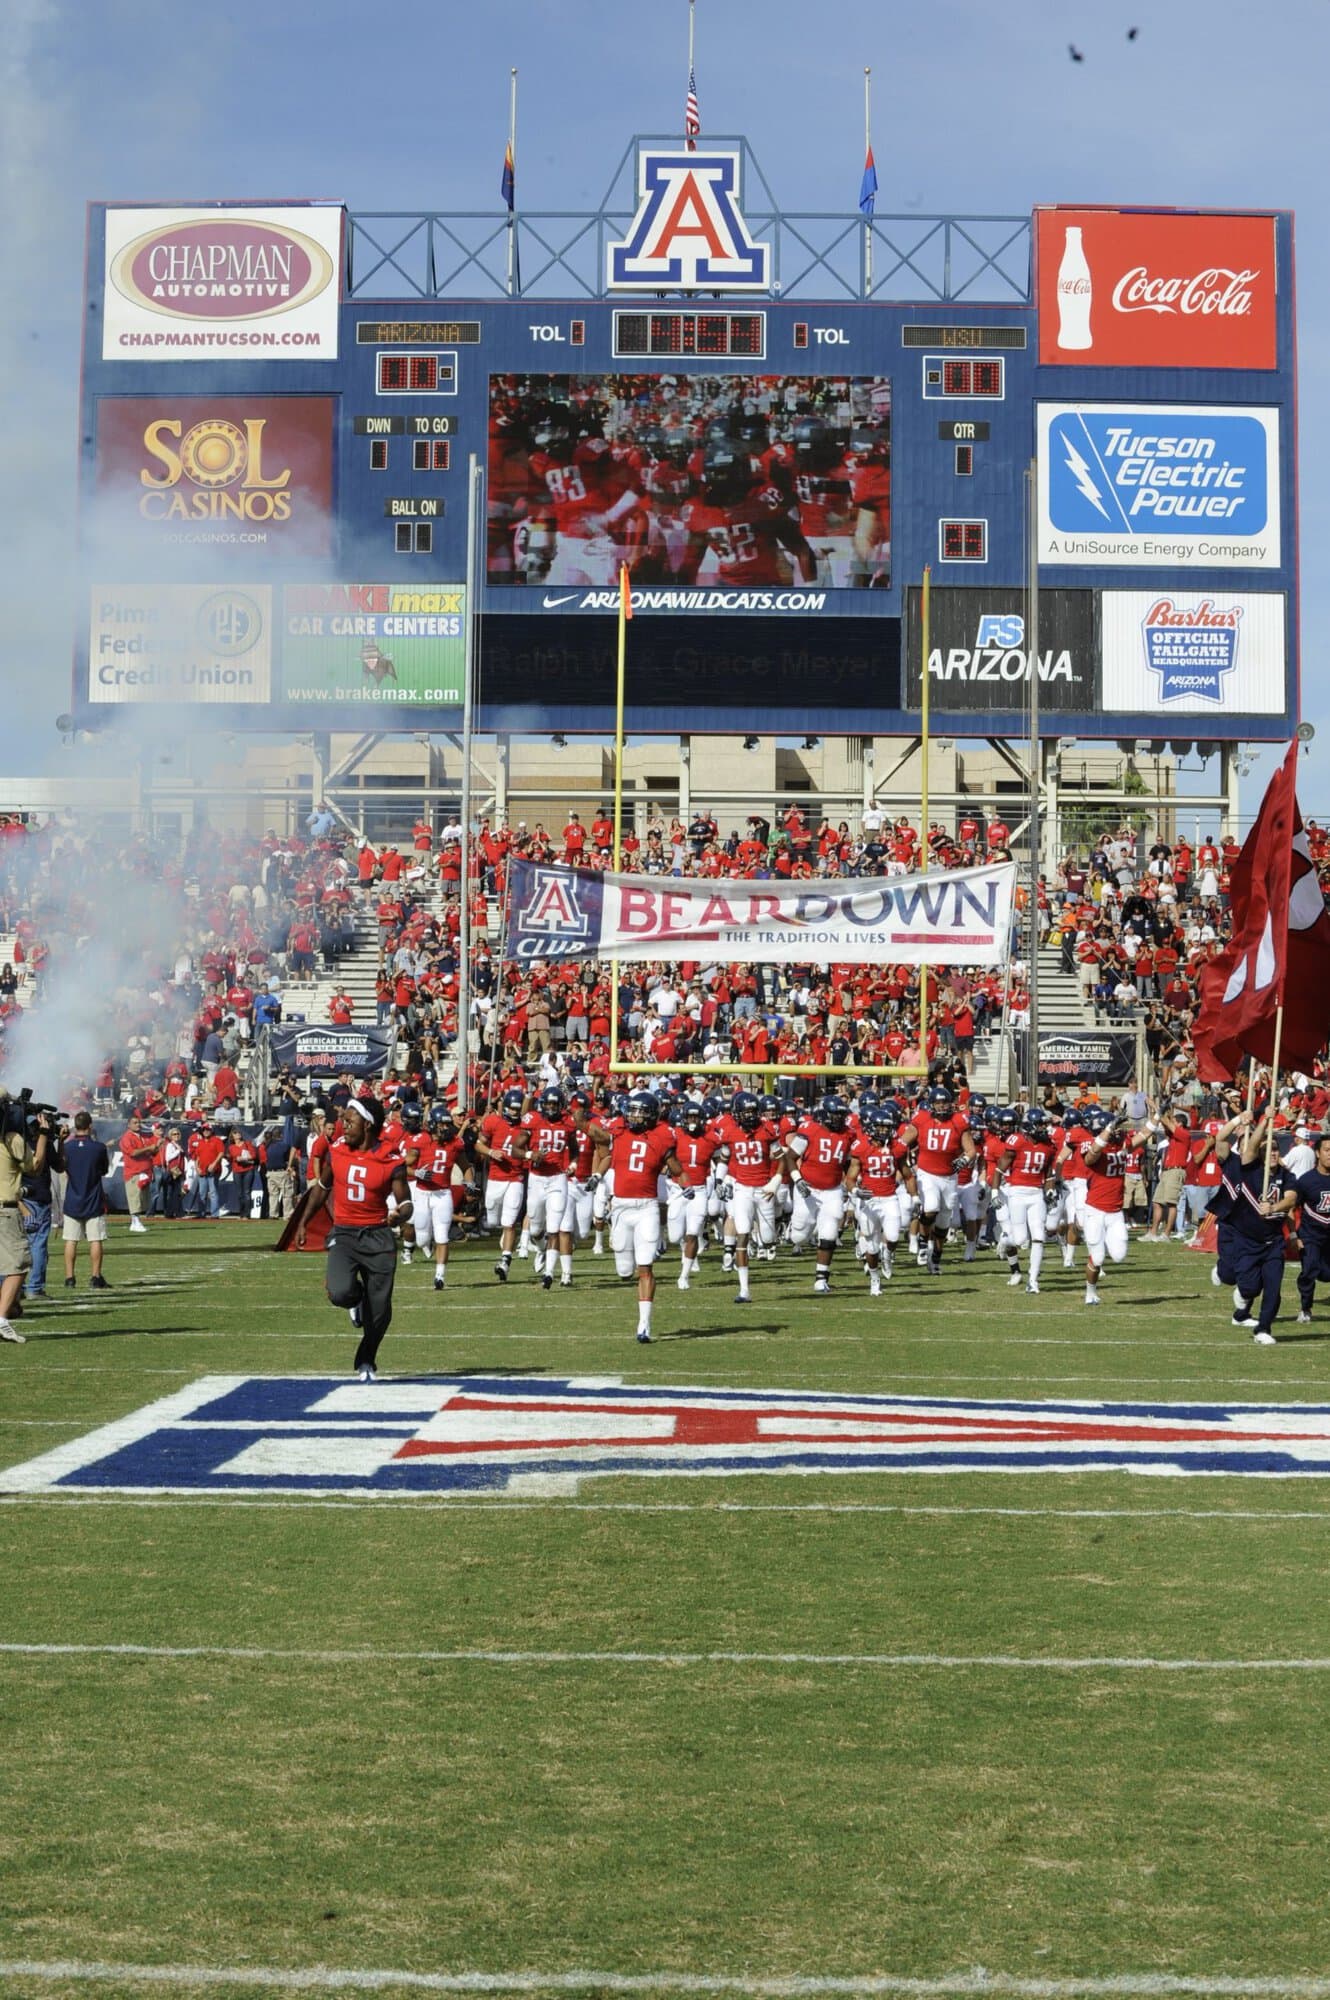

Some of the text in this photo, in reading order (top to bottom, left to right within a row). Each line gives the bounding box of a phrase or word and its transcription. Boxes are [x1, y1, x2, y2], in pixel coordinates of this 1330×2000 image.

[607, 151, 770, 289] A
[148, 245, 293, 282] CHAPMAN
[152, 284, 290, 297] AUTOMOTIVE
[1112, 266, 1260, 315] Coca-Cola
[119, 333, 321, 346] CHAPMANTUCSON.COM
[378, 324, 460, 342] ARIZONA
[529, 326, 565, 341] TOL
[813, 328, 850, 344] TOL
[366, 418, 391, 433] DWN
[415, 418, 449, 433] TO GO
[953, 423, 975, 439] QTR
[141, 419, 291, 489] SOL
[1105, 428, 1215, 458] Tucson
[1116, 458, 1246, 488] Electric
[139, 491, 292, 521] CASINOS
[392, 500, 437, 515] BALL ON
[1129, 488, 1246, 518] Power
[944, 524, 982, 556] 25
[1048, 541, 1267, 559] A UniSource Energy Company
[391, 592, 464, 614] max
[1146, 601, 1239, 626] Bashas'
[288, 617, 460, 635] CAR CARE CENTERS
[976, 615, 1024, 648] FS
[1152, 632, 1229, 644] OFFICIAL
[1152, 645, 1229, 656] TAILGATE
[919, 649, 1073, 681] ARIZONA
[1152, 658, 1228, 666] HEADQUARTERS
[181, 664, 253, 685] Union
[1166, 675, 1216, 685] ARIZONA
[288, 687, 459, 700] www.brakemax.com
[518, 869, 588, 936] A
[517, 938, 587, 956] CLUB
[726, 932, 886, 944] THE TRADITION LIVES
[1040, 1045, 1110, 1053] AMERICAN FAMILY
[539, 1129, 566, 1153] 26
[819, 1138, 843, 1163] 54
[927, 1129, 951, 1151] 67
[432, 1150, 447, 1174] 2
[629, 1140, 647, 1172] 2
[688, 1144, 697, 1168] 1
[735, 1141, 763, 1165] 23
[1021, 1151, 1046, 1174] 19
[868, 1156, 895, 1178] 23
[347, 1165, 368, 1202] 5
